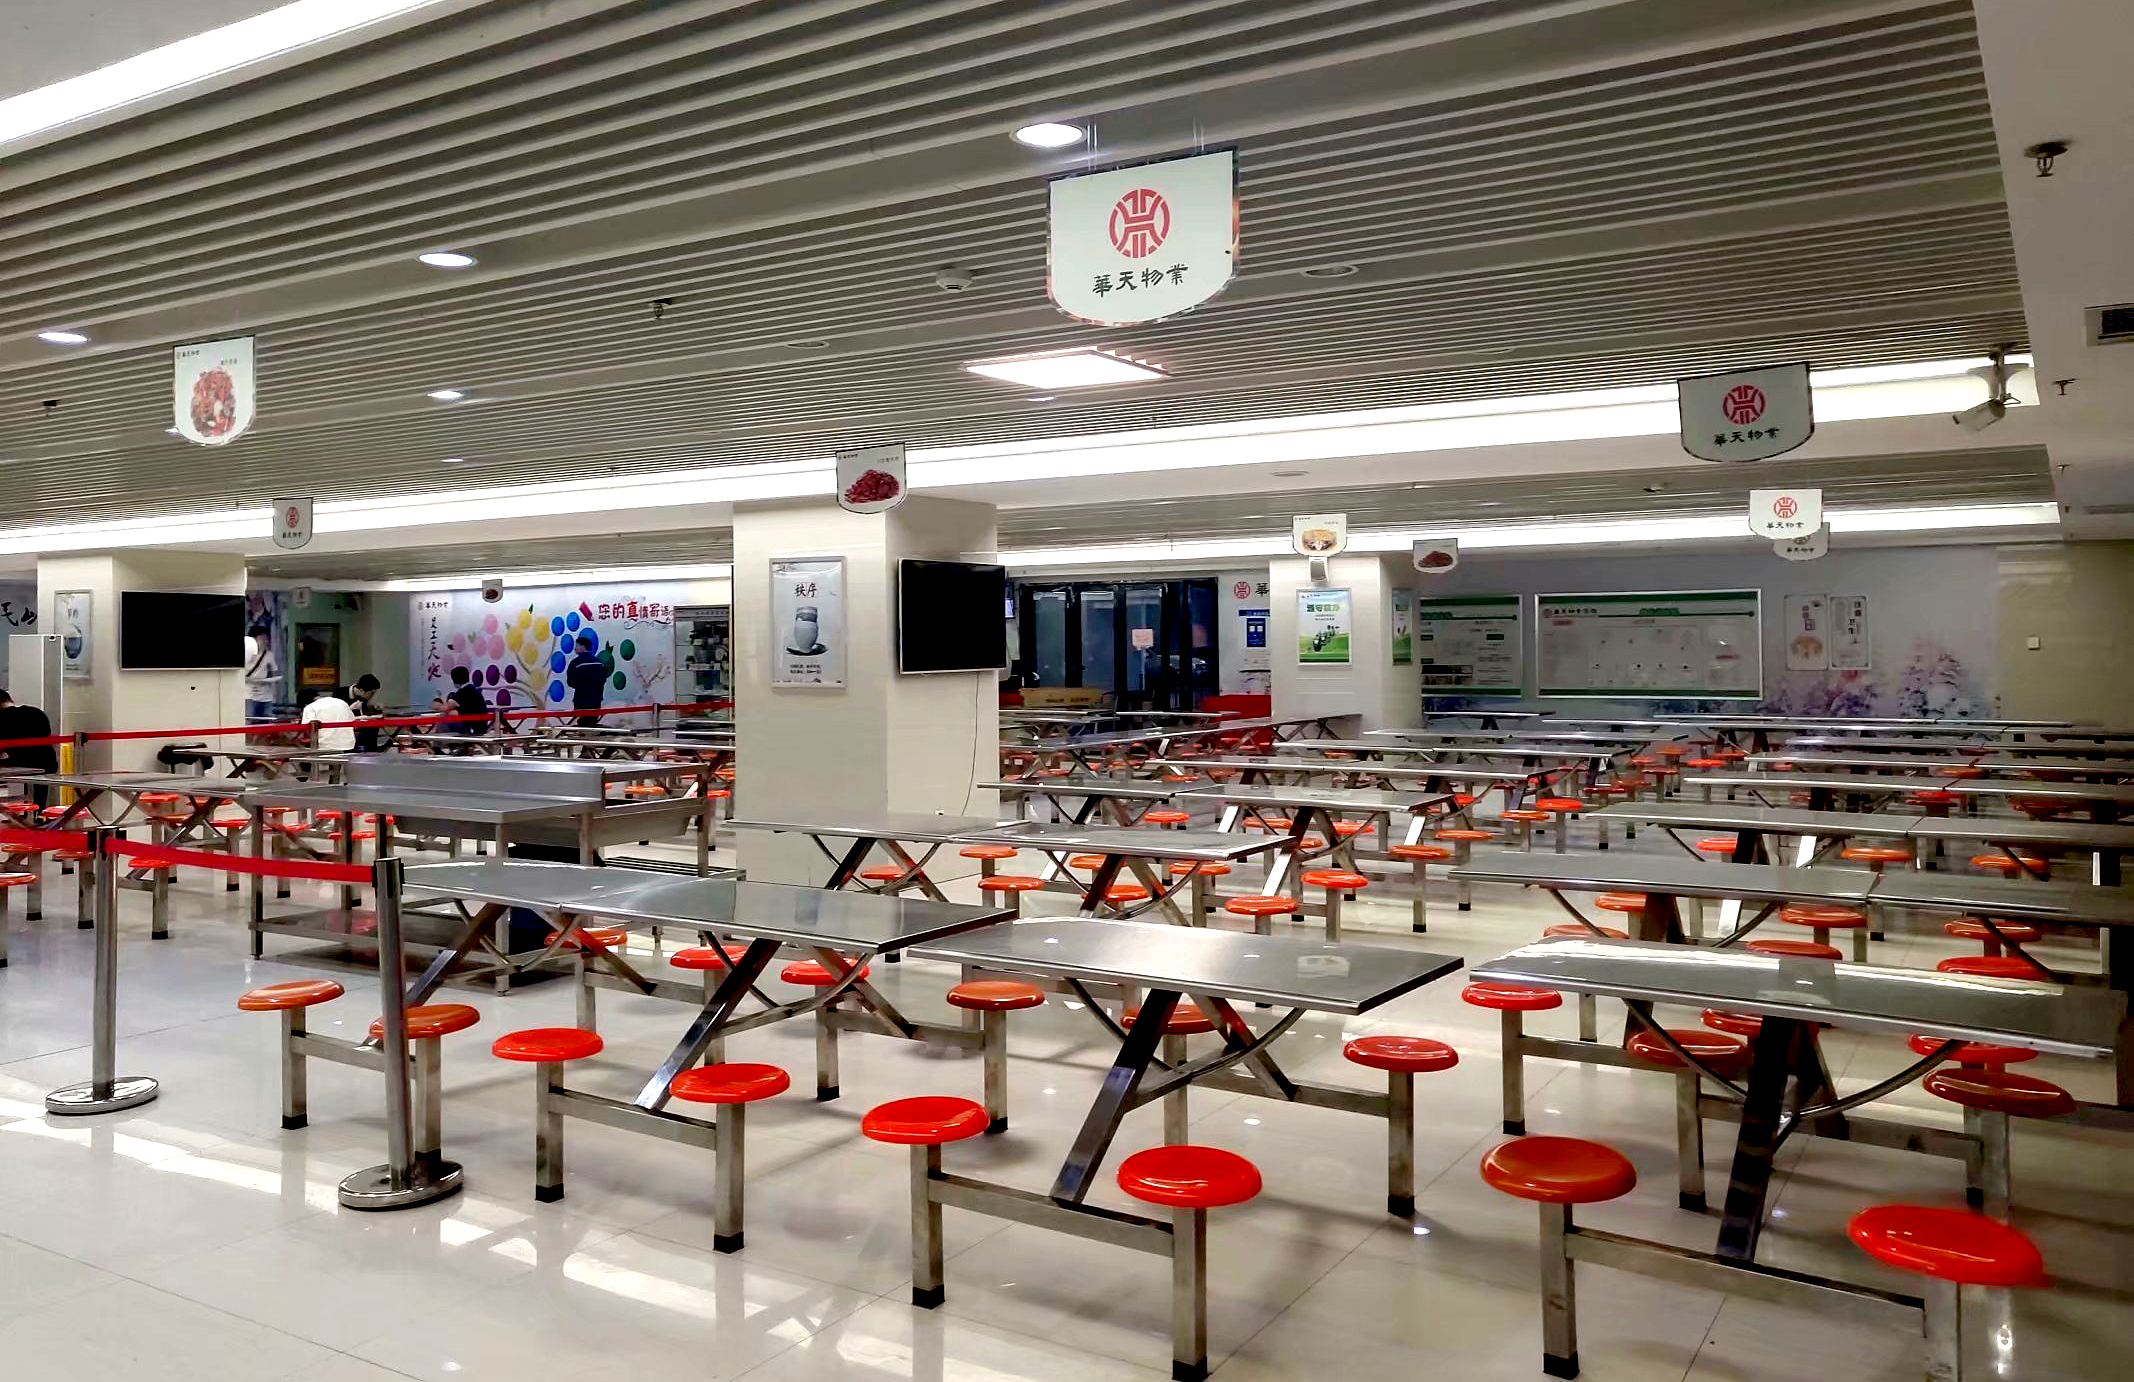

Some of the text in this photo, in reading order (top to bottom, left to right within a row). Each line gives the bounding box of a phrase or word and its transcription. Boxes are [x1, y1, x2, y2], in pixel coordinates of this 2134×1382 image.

[1092, 263, 1188, 297] 華天物業
[1713, 427, 1780, 447] 華天物業
[794, 583, 818, 598] 秩序
